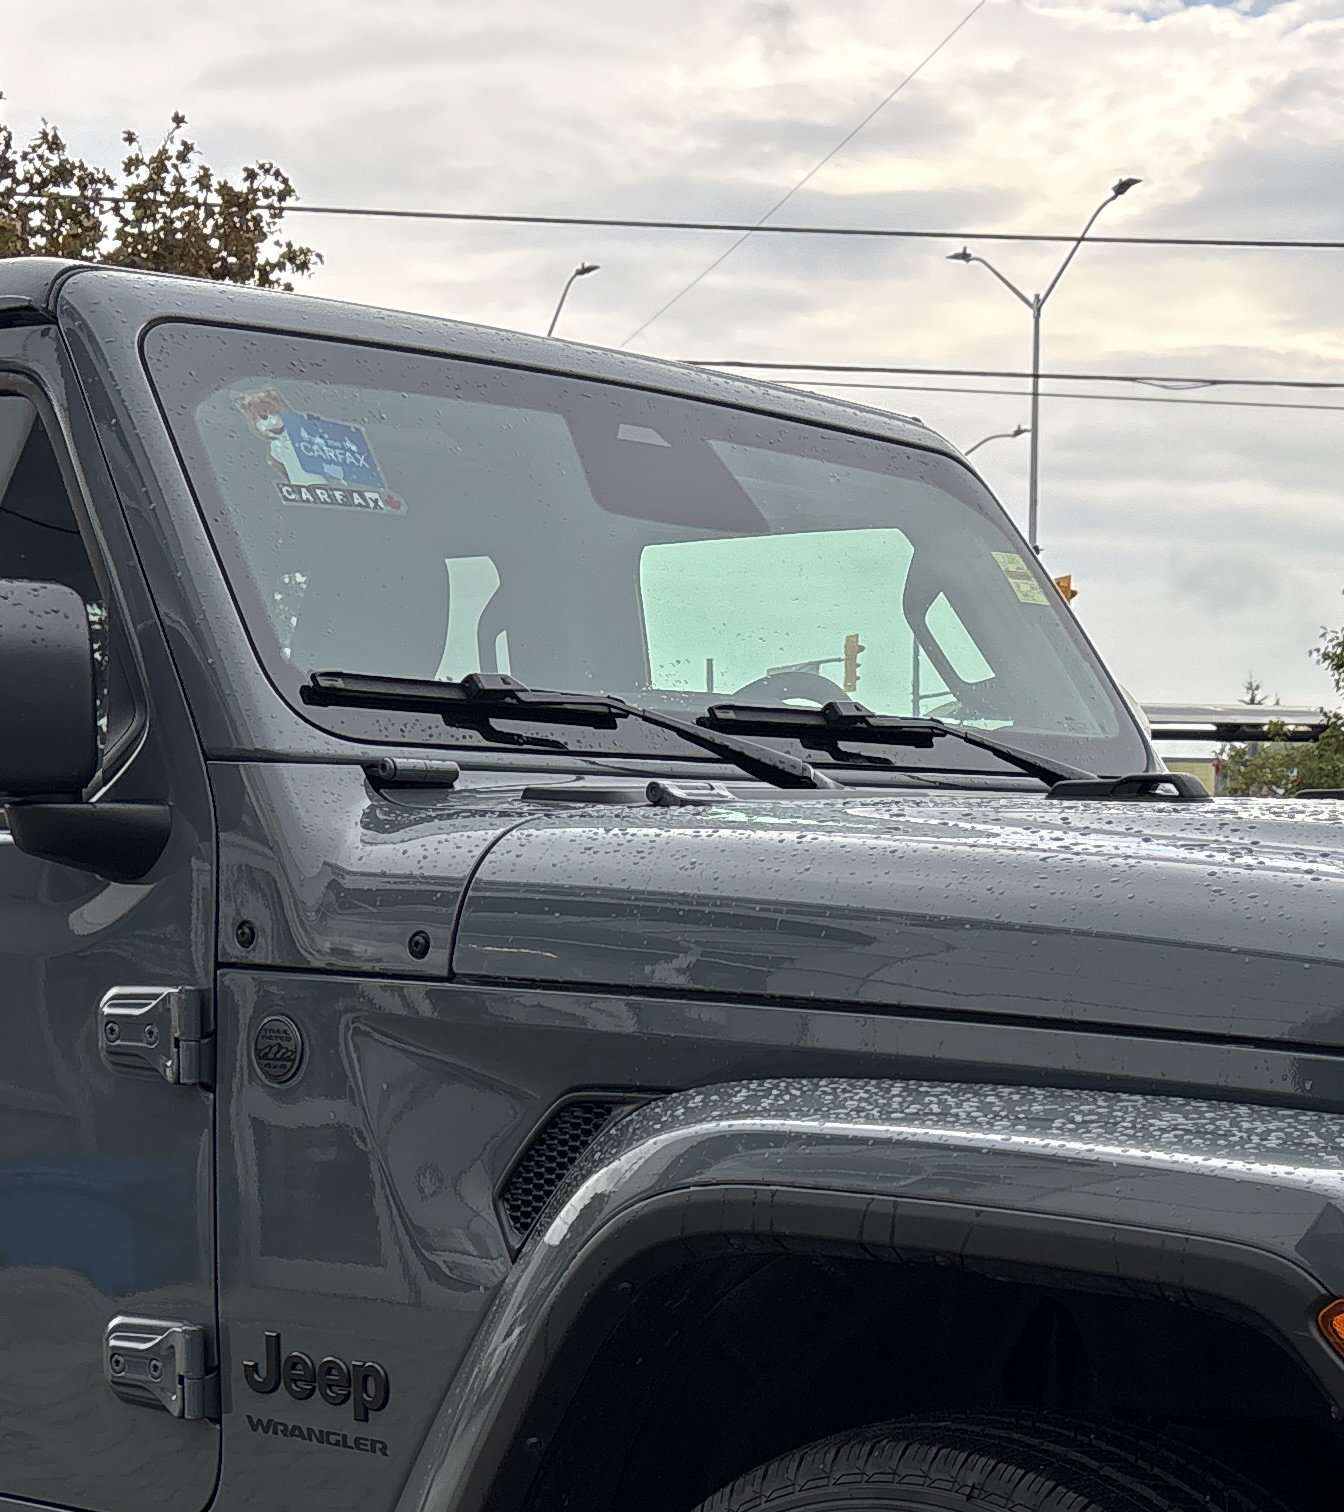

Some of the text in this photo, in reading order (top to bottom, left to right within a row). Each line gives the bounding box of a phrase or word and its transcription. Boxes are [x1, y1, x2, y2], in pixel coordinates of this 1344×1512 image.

[300, 442, 370, 469] CARFAX
[281, 486, 385, 510] CARFAX
[242, 1330, 390, 1423] Jeep
[245, 1414, 390, 1457] WRANGLER
